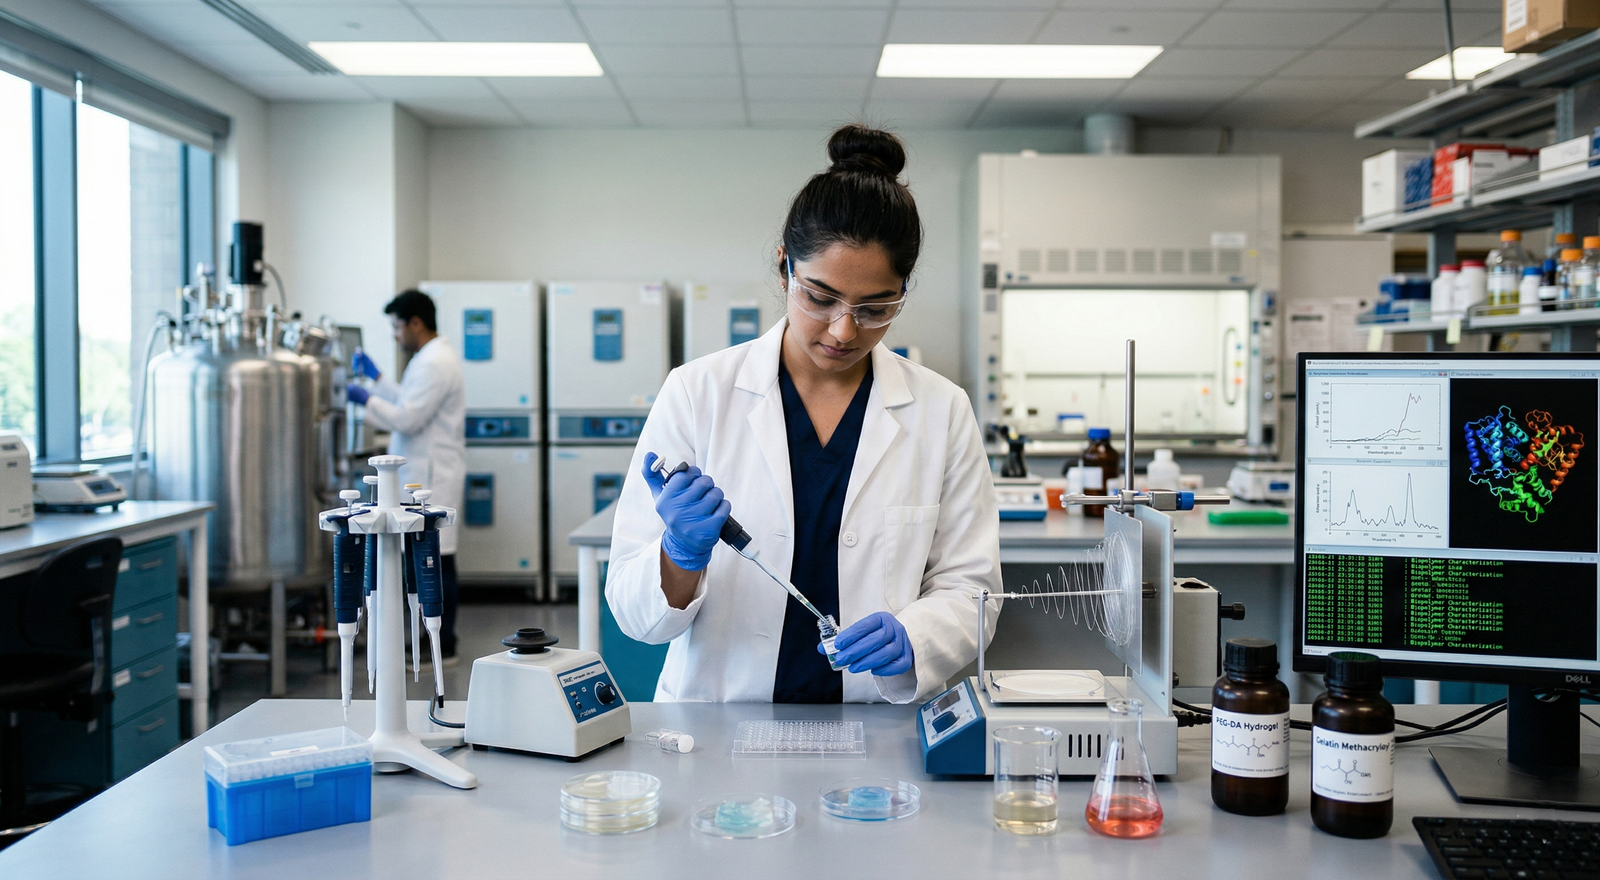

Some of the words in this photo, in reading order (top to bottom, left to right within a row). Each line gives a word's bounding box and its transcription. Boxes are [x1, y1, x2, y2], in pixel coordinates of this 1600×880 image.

[1566, 674, 1591, 684] DELL
[1216, 716, 1242, 729] PEG-DA
[1244, 722, 1279, 732] Hydrogel
